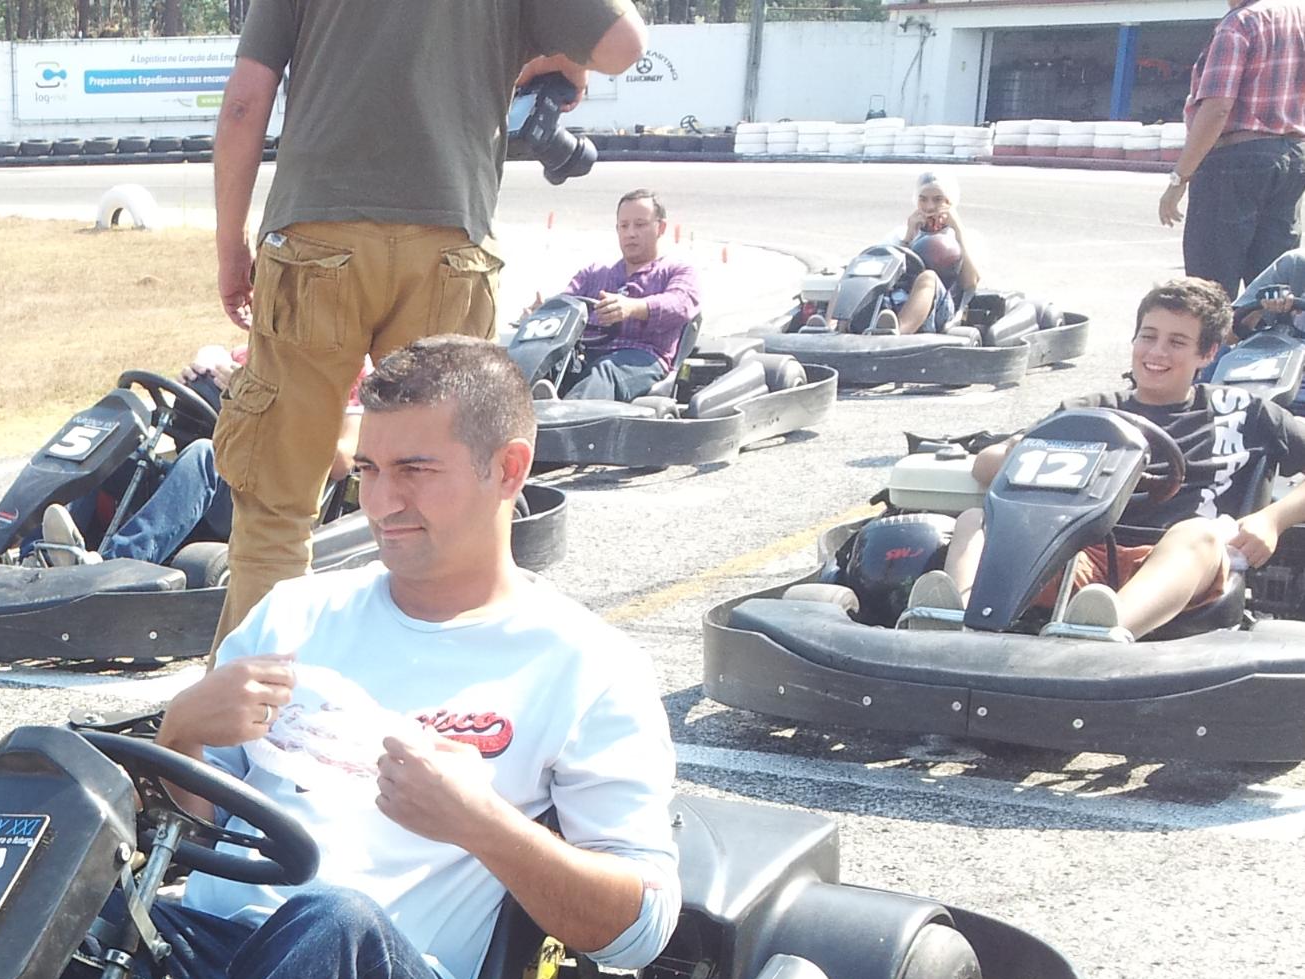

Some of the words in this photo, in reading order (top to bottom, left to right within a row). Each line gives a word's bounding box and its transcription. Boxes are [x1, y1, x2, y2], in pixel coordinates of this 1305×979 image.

[522, 318, 561, 339] 10
[1229, 358, 1280, 379] 4
[49, 426, 102, 456] 5
[1014, 449, 1088, 487] 12
[5, 819, 41, 836] XXI
